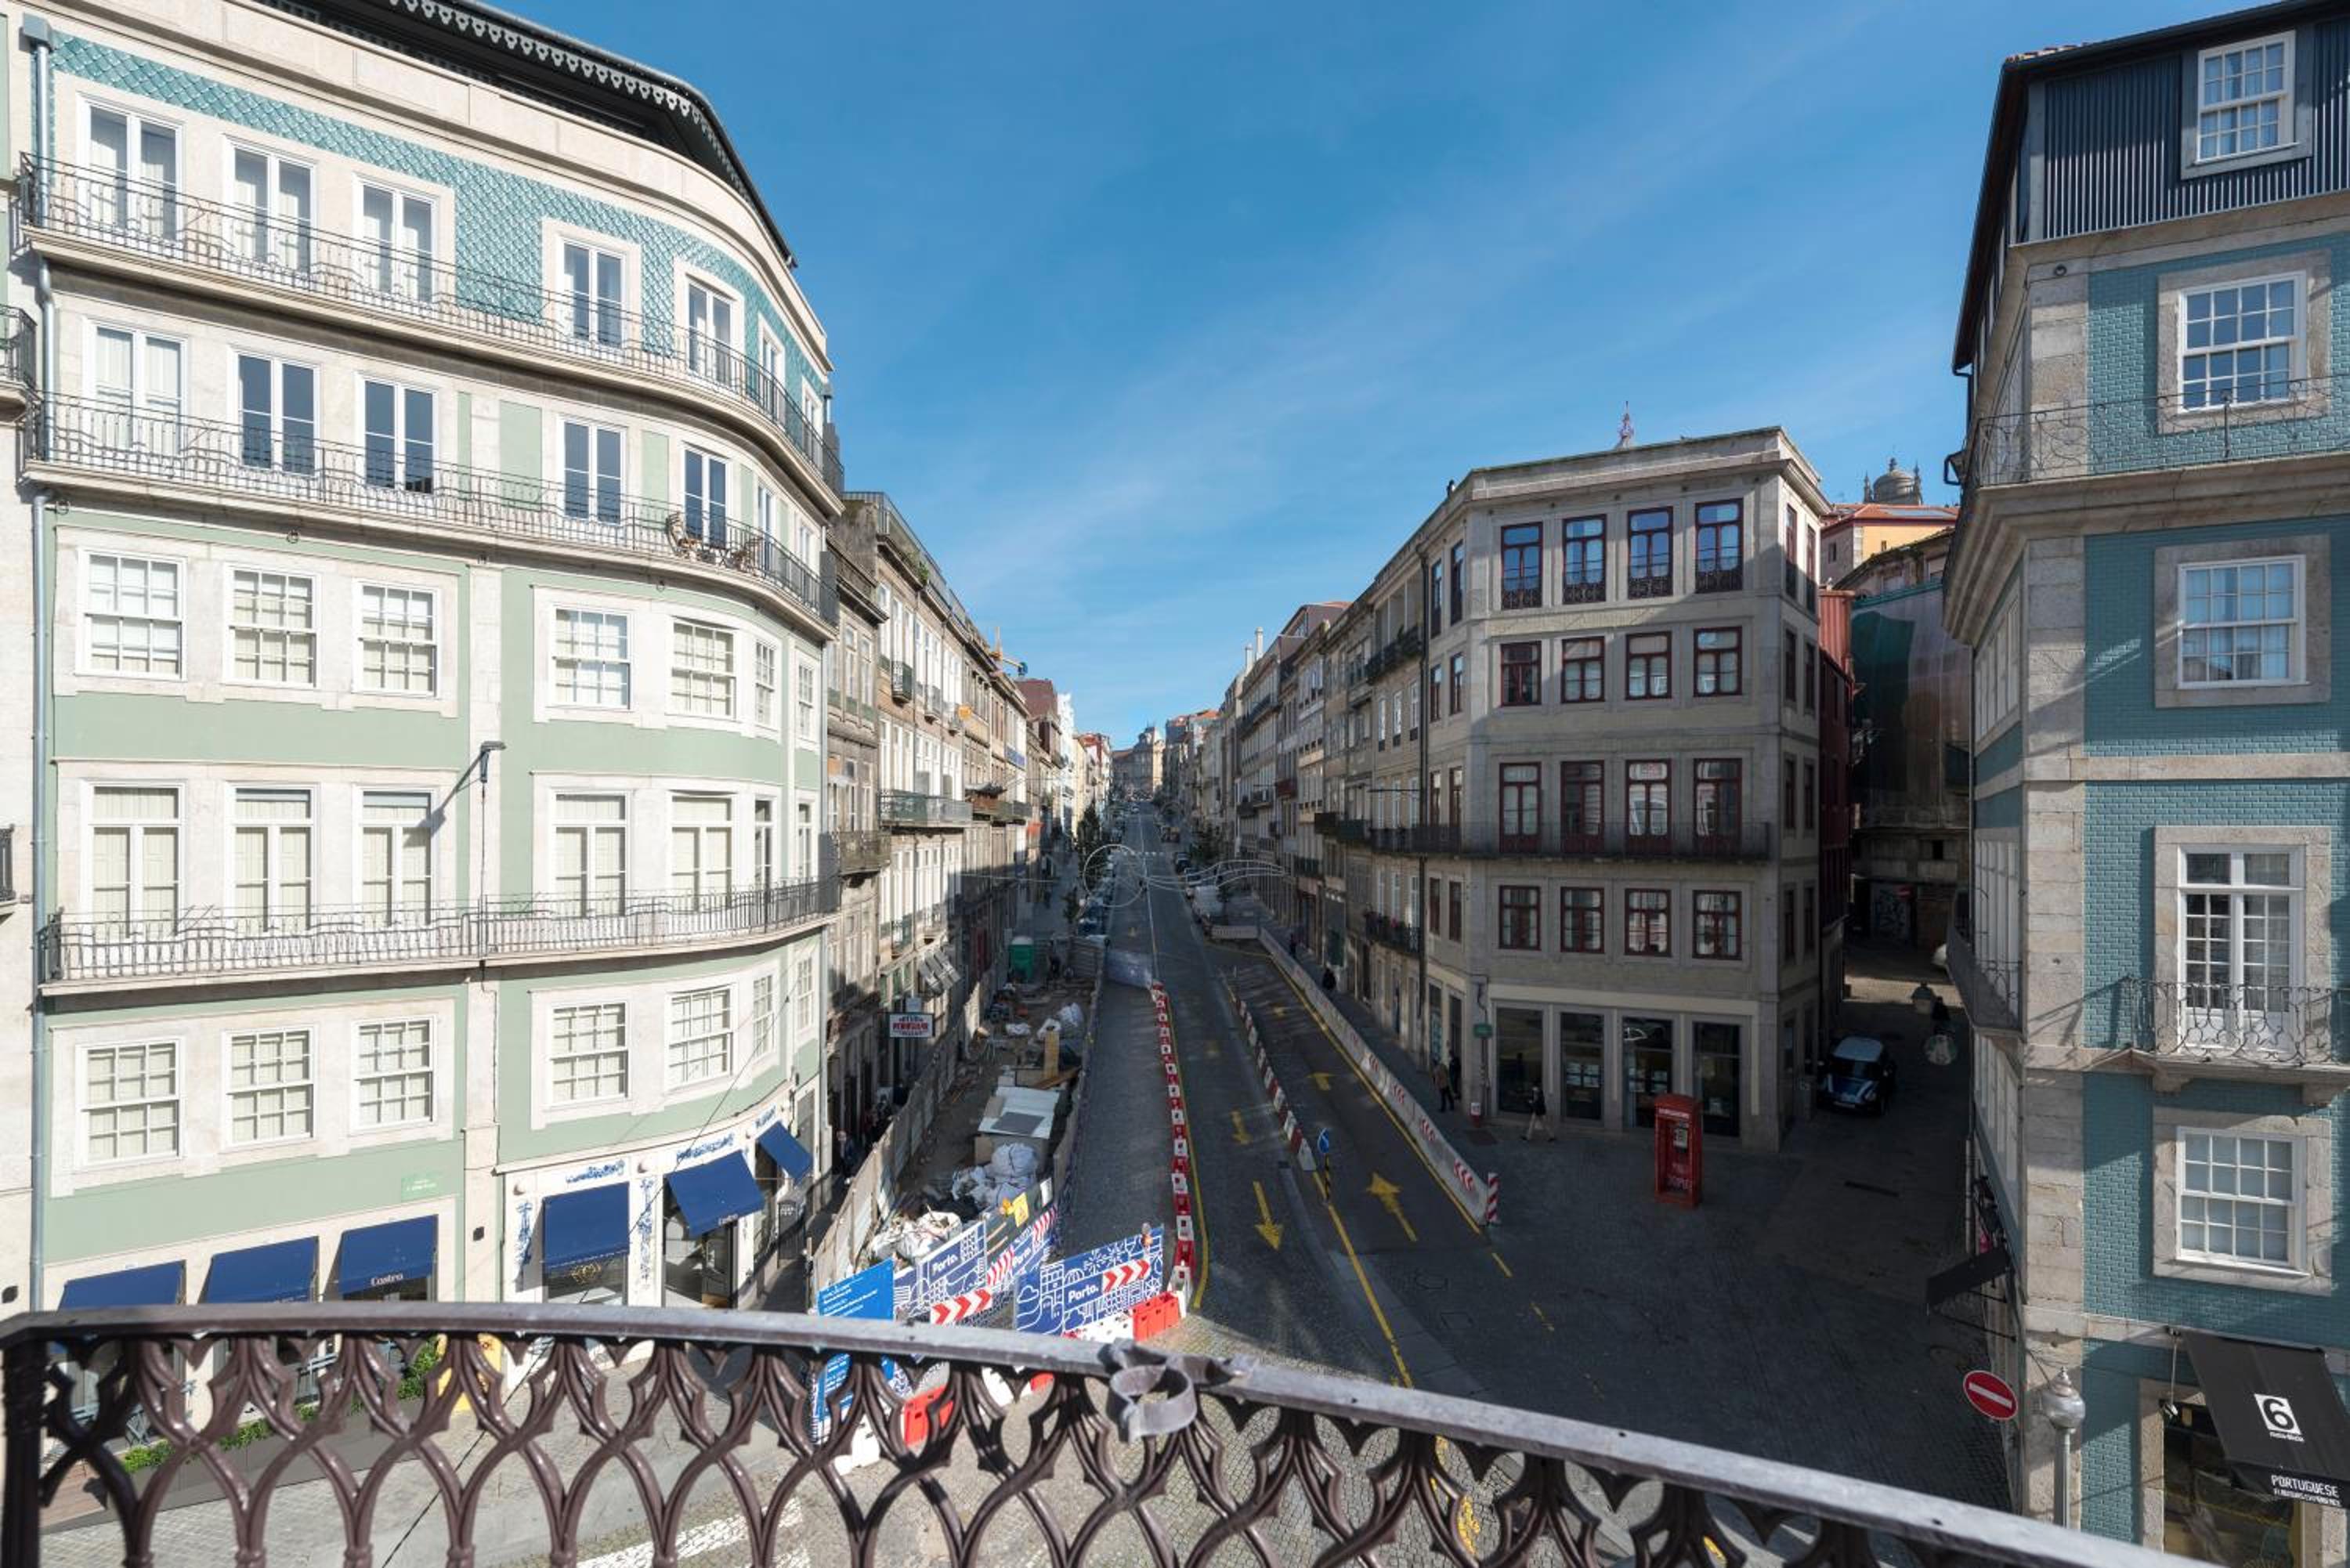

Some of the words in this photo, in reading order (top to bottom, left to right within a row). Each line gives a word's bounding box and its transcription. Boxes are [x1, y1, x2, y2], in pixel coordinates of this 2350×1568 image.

[1068, 1284, 1099, 1303] Porto.
[2263, 1398, 2294, 1430] 6
[2272, 1475, 2339, 1498] PORTUGUESE
